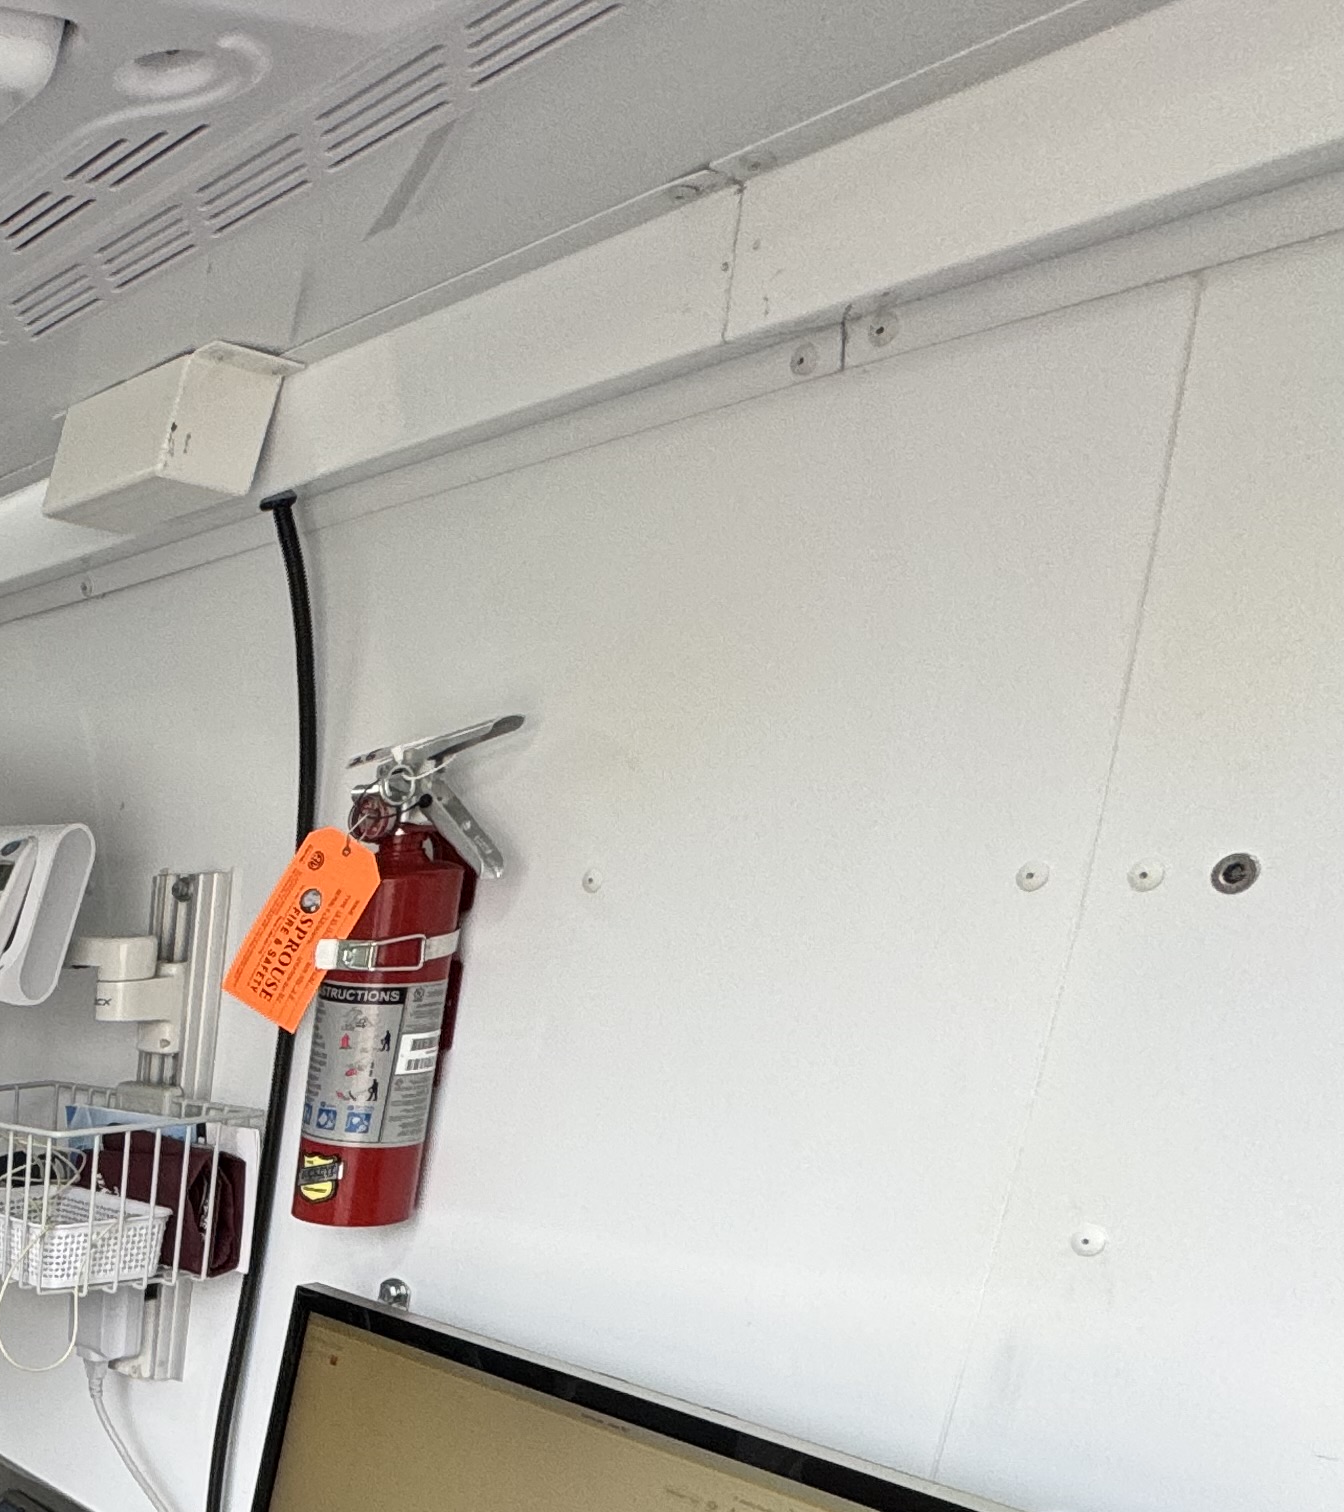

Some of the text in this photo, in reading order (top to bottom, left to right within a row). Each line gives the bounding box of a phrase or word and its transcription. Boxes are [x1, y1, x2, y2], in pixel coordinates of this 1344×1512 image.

[280, 907, 301, 936] FIRE
[249, 949, 277, 993] SAFETY
[260, 913, 313, 1002] SPROUSE
[319, 988, 401, 1001] STRUCTIONS
